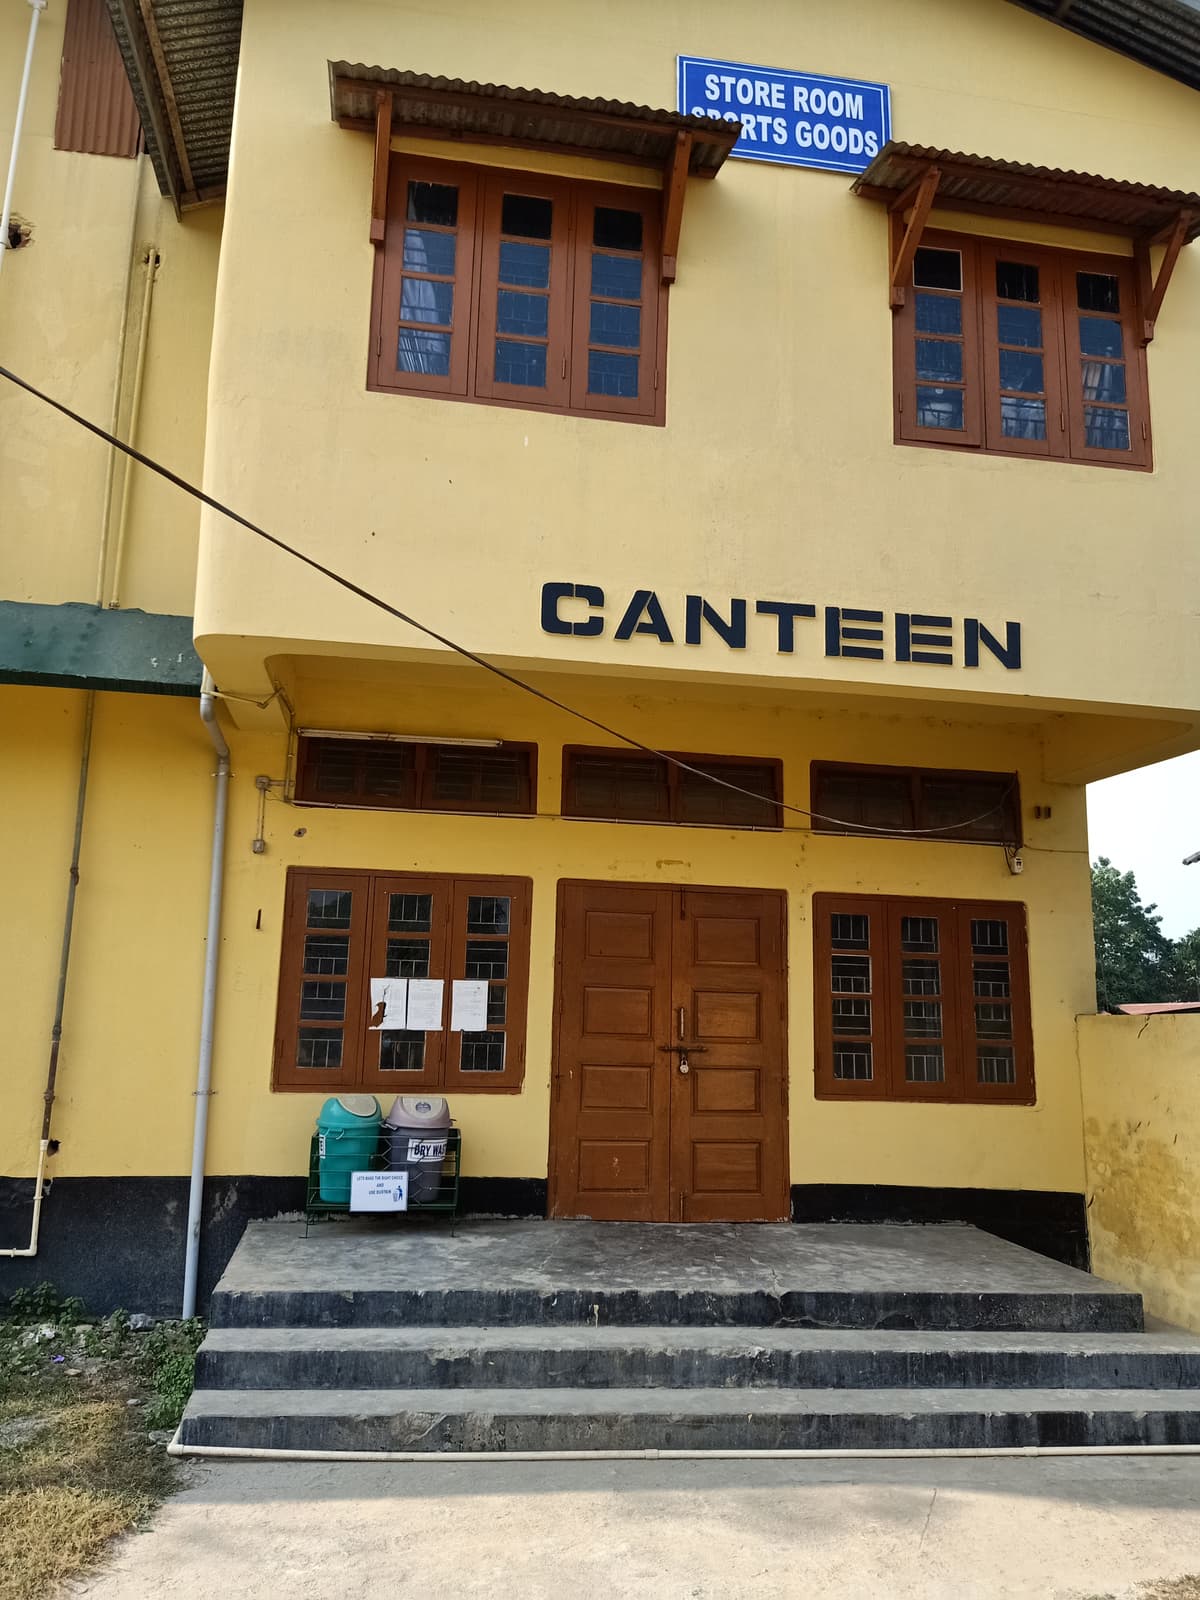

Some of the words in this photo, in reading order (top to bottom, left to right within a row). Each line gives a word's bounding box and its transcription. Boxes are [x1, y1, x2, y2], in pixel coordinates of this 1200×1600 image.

[705, 74, 786, 110] STORE
[793, 86, 864, 121] ROOM
[795, 121, 879, 157] GOODS
[540, 582, 1021, 669] CANTEEN
[414, 1144, 431, 1156] DRY
